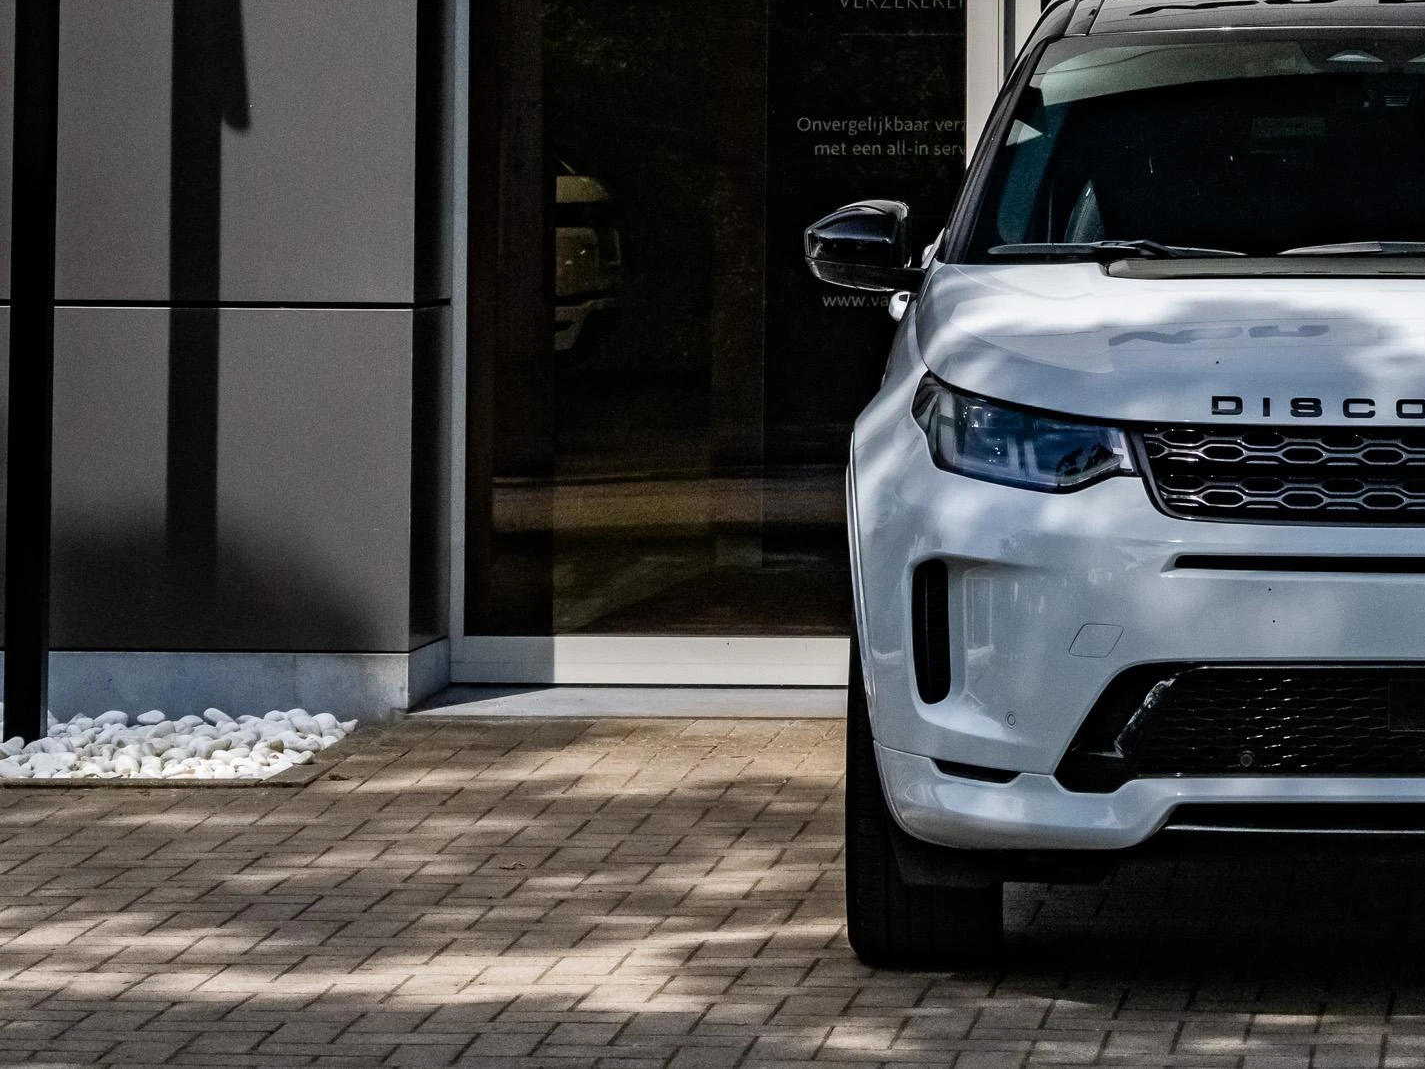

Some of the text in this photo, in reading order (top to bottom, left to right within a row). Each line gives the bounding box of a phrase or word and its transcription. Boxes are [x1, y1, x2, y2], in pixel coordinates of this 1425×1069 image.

[796, 115, 930, 136] Onvergelijkbaar
[814, 141, 847, 156] met
[852, 144, 882, 156] een
[886, 139, 929, 156] all-in
